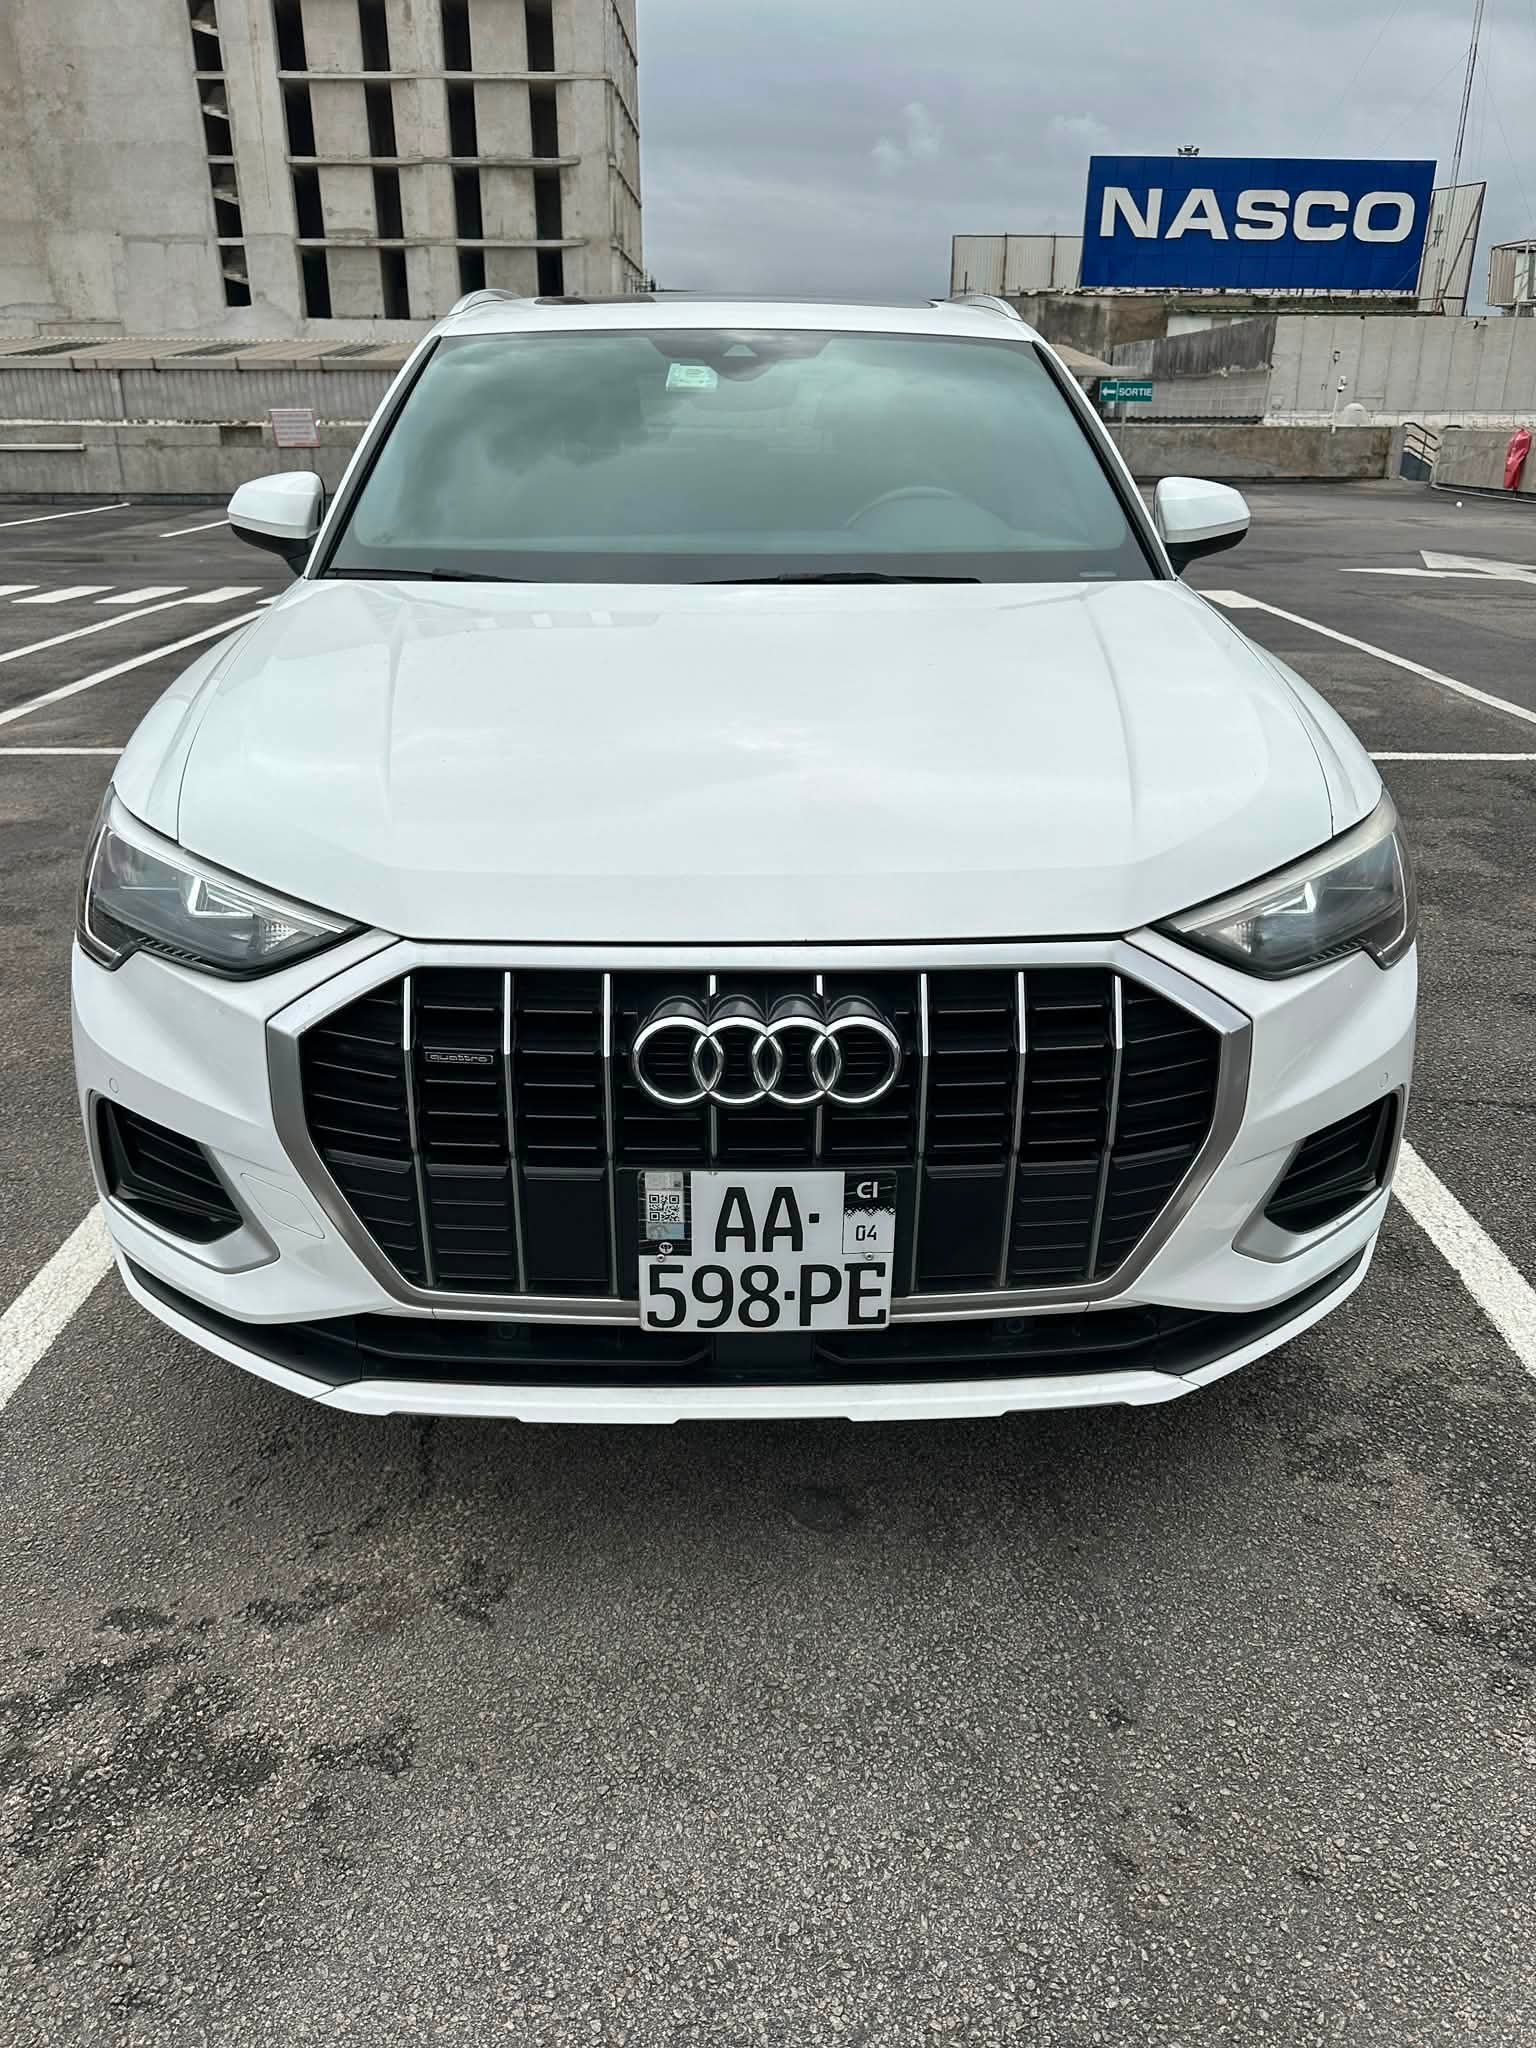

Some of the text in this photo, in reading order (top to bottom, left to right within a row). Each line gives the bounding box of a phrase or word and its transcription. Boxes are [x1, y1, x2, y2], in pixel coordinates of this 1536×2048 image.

[1099, 186, 1416, 243] NASCO
[1119, 387, 1153, 397] SORTIE
[429, 1054, 488, 1063] quattro
[856, 1181, 879, 1199] CI
[855, 1224, 878, 1241] 04
